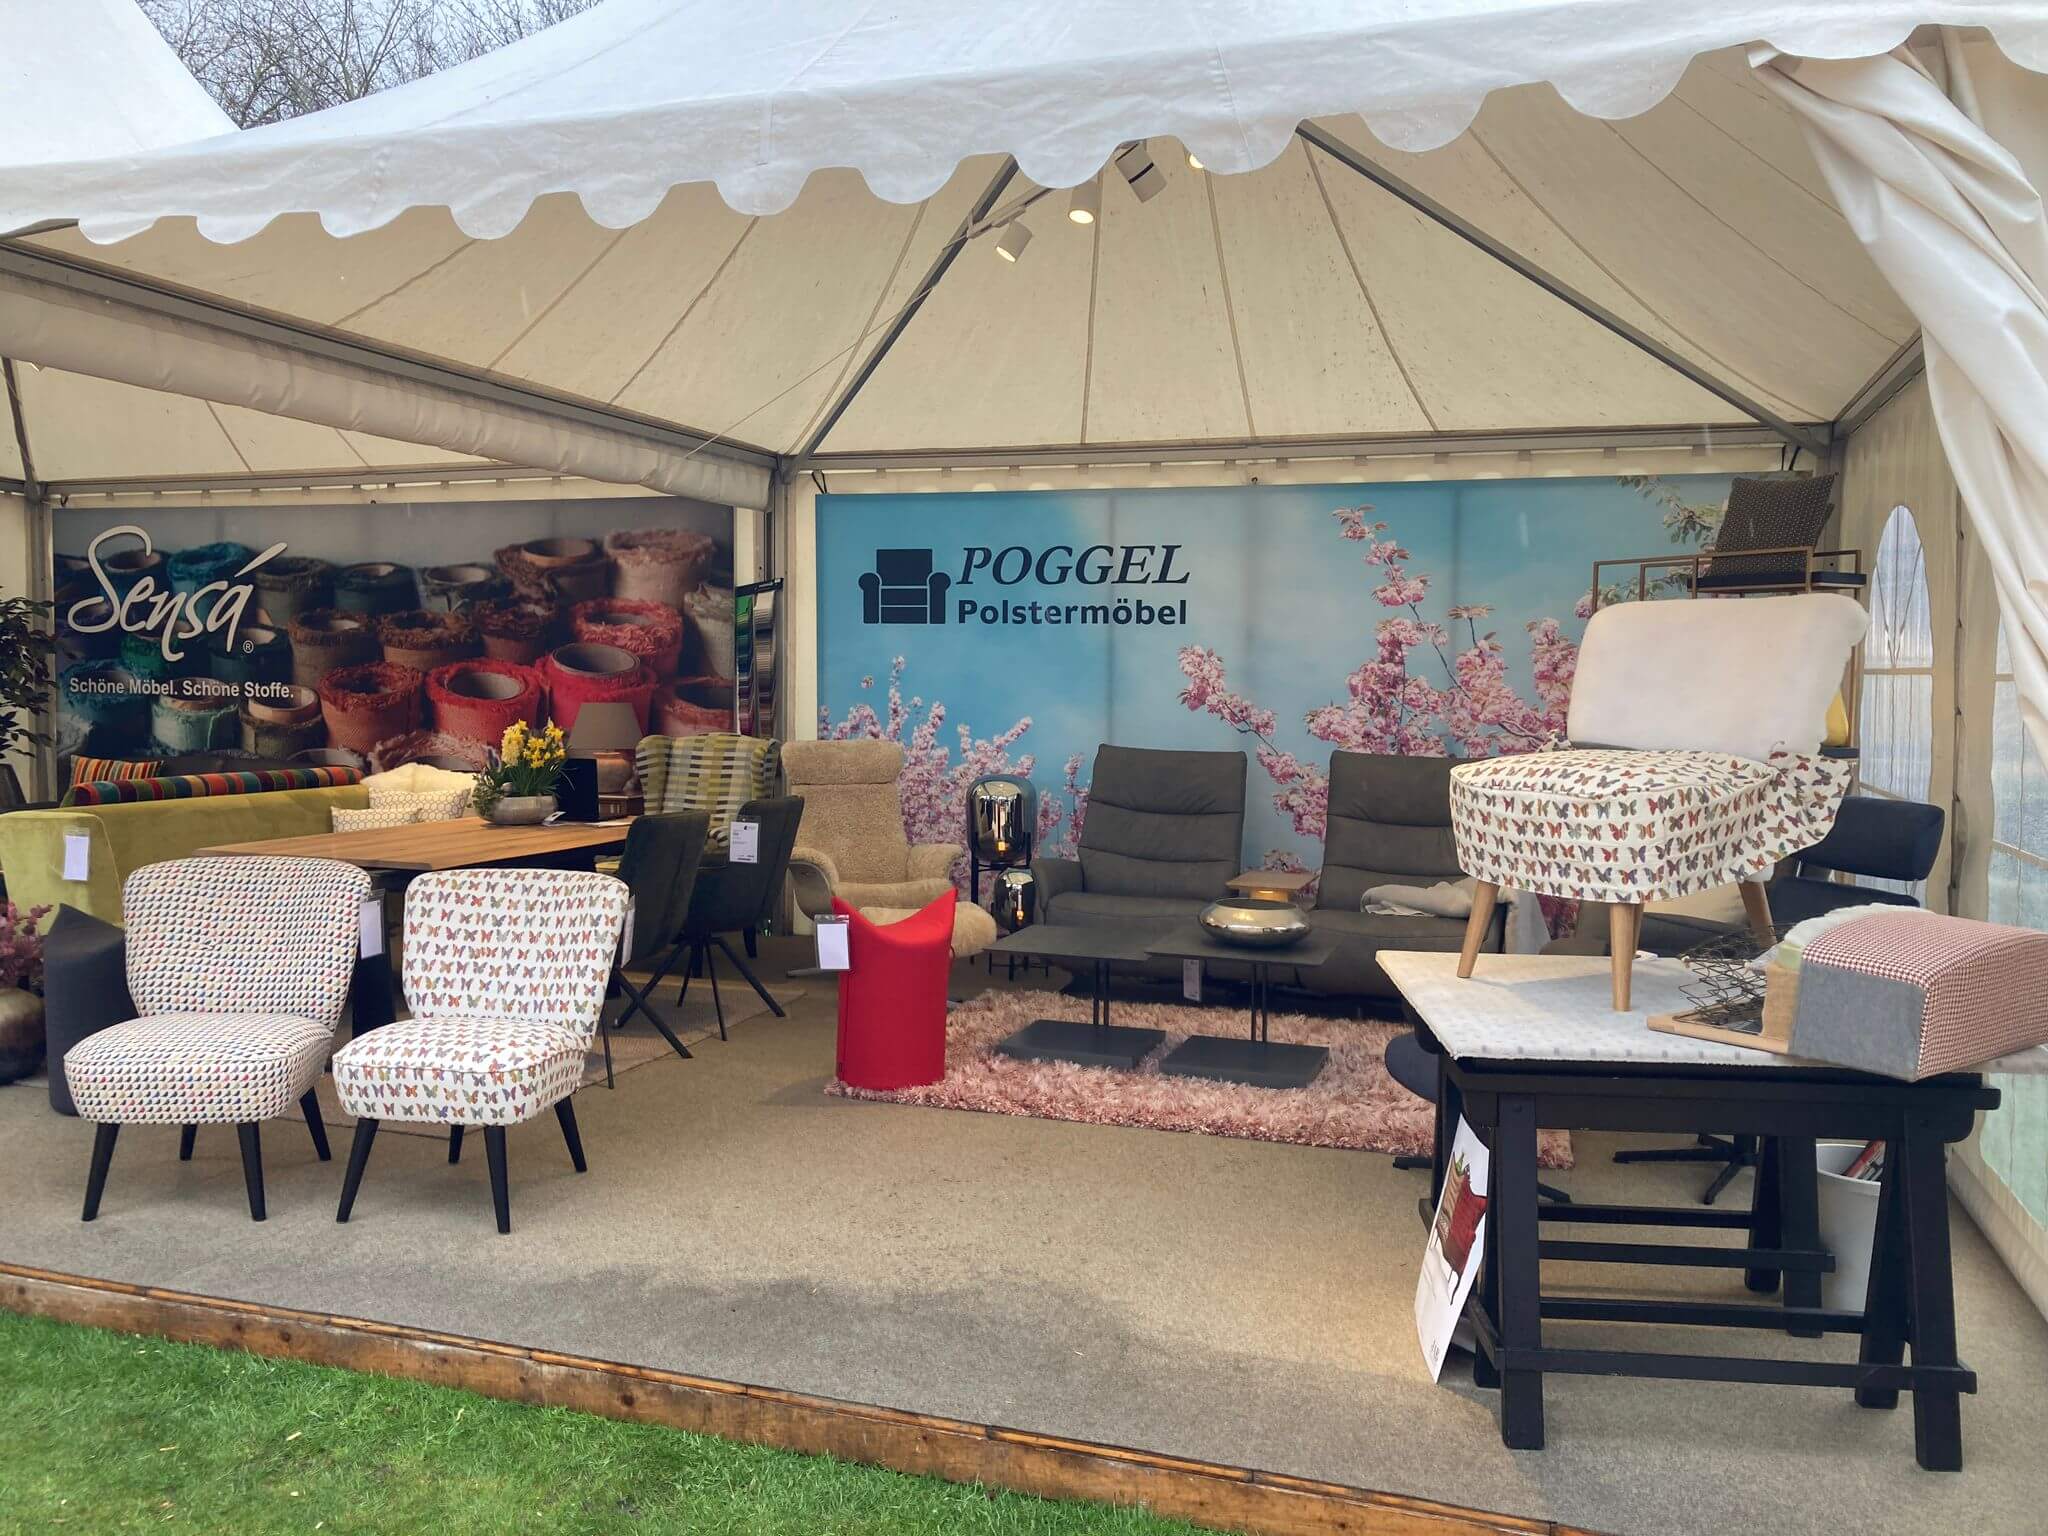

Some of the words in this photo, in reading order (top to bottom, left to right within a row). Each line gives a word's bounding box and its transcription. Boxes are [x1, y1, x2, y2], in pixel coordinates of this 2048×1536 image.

[955, 545, 1190, 585] POGGEL
[958, 599, 1187, 625] Polstermöbel
[70, 678, 125, 694] Schöne
[129, 679, 178, 696] Möbel.
[183, 680, 239, 697] Schöne
[244, 681, 295, 698] Stoffe.
